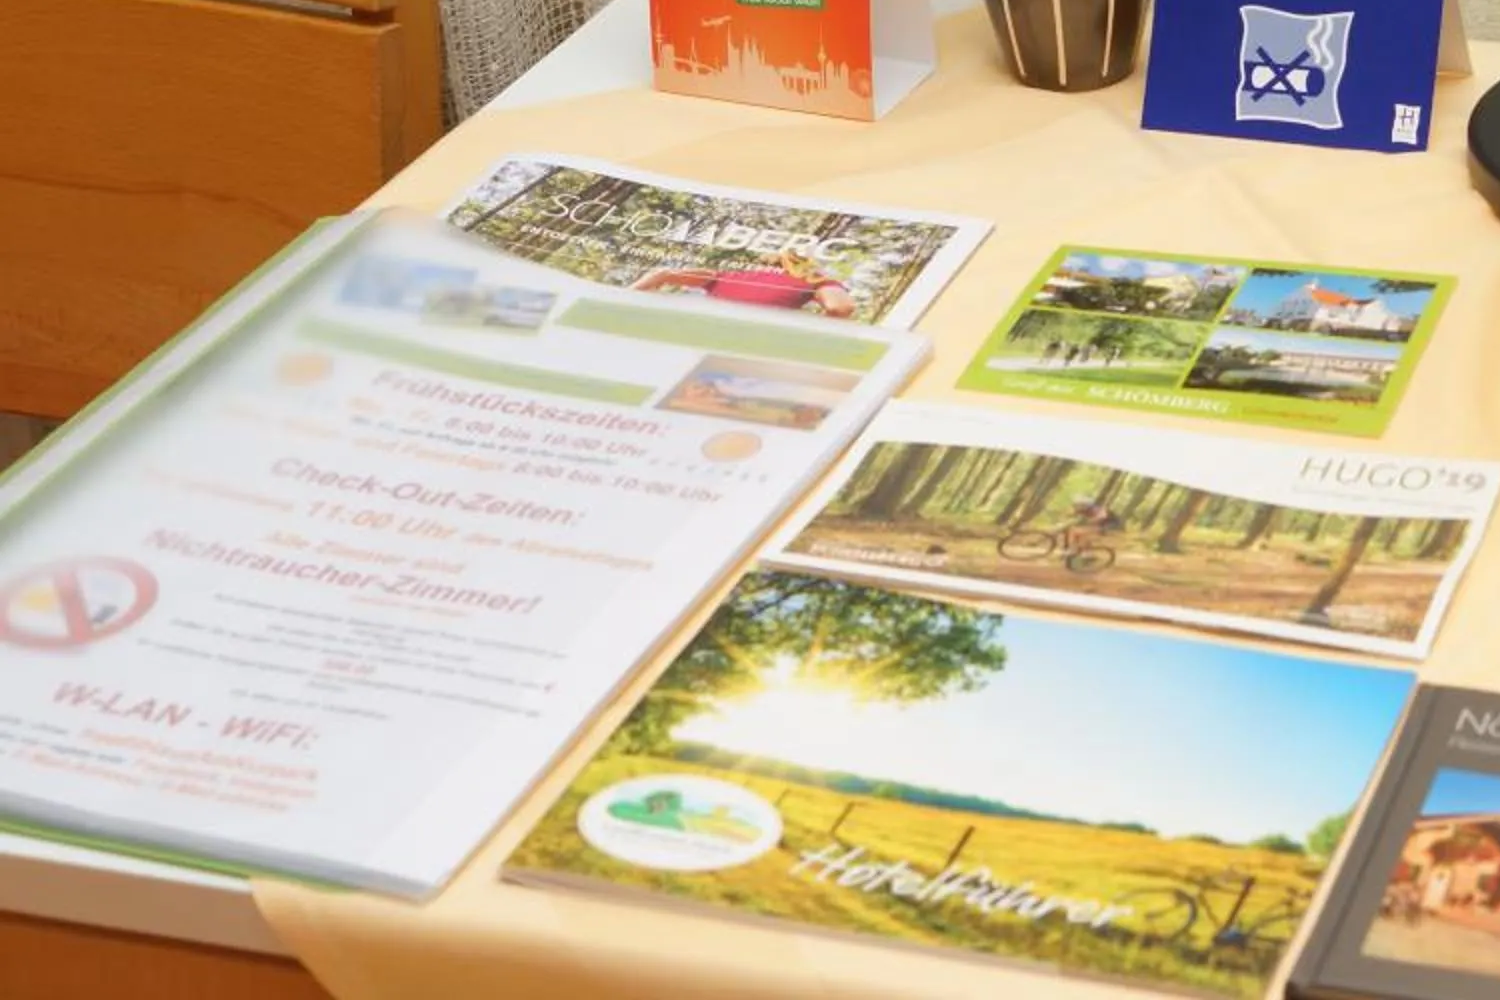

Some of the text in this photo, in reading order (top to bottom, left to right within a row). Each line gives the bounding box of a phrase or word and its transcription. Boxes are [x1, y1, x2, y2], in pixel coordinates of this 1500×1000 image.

[541, 192, 858, 262] SCHÖMBERG
[372, 369, 671, 437] Frühstückszeiten:
[270, 455, 586, 527] Check-Out-Zeiten:
[306, 500, 393, 529] 11:00
[397, 516, 460, 541] Uhr
[145, 527, 543, 615] Nichtraucher-Zimmer!
[53, 682, 192, 727] W-LAN
